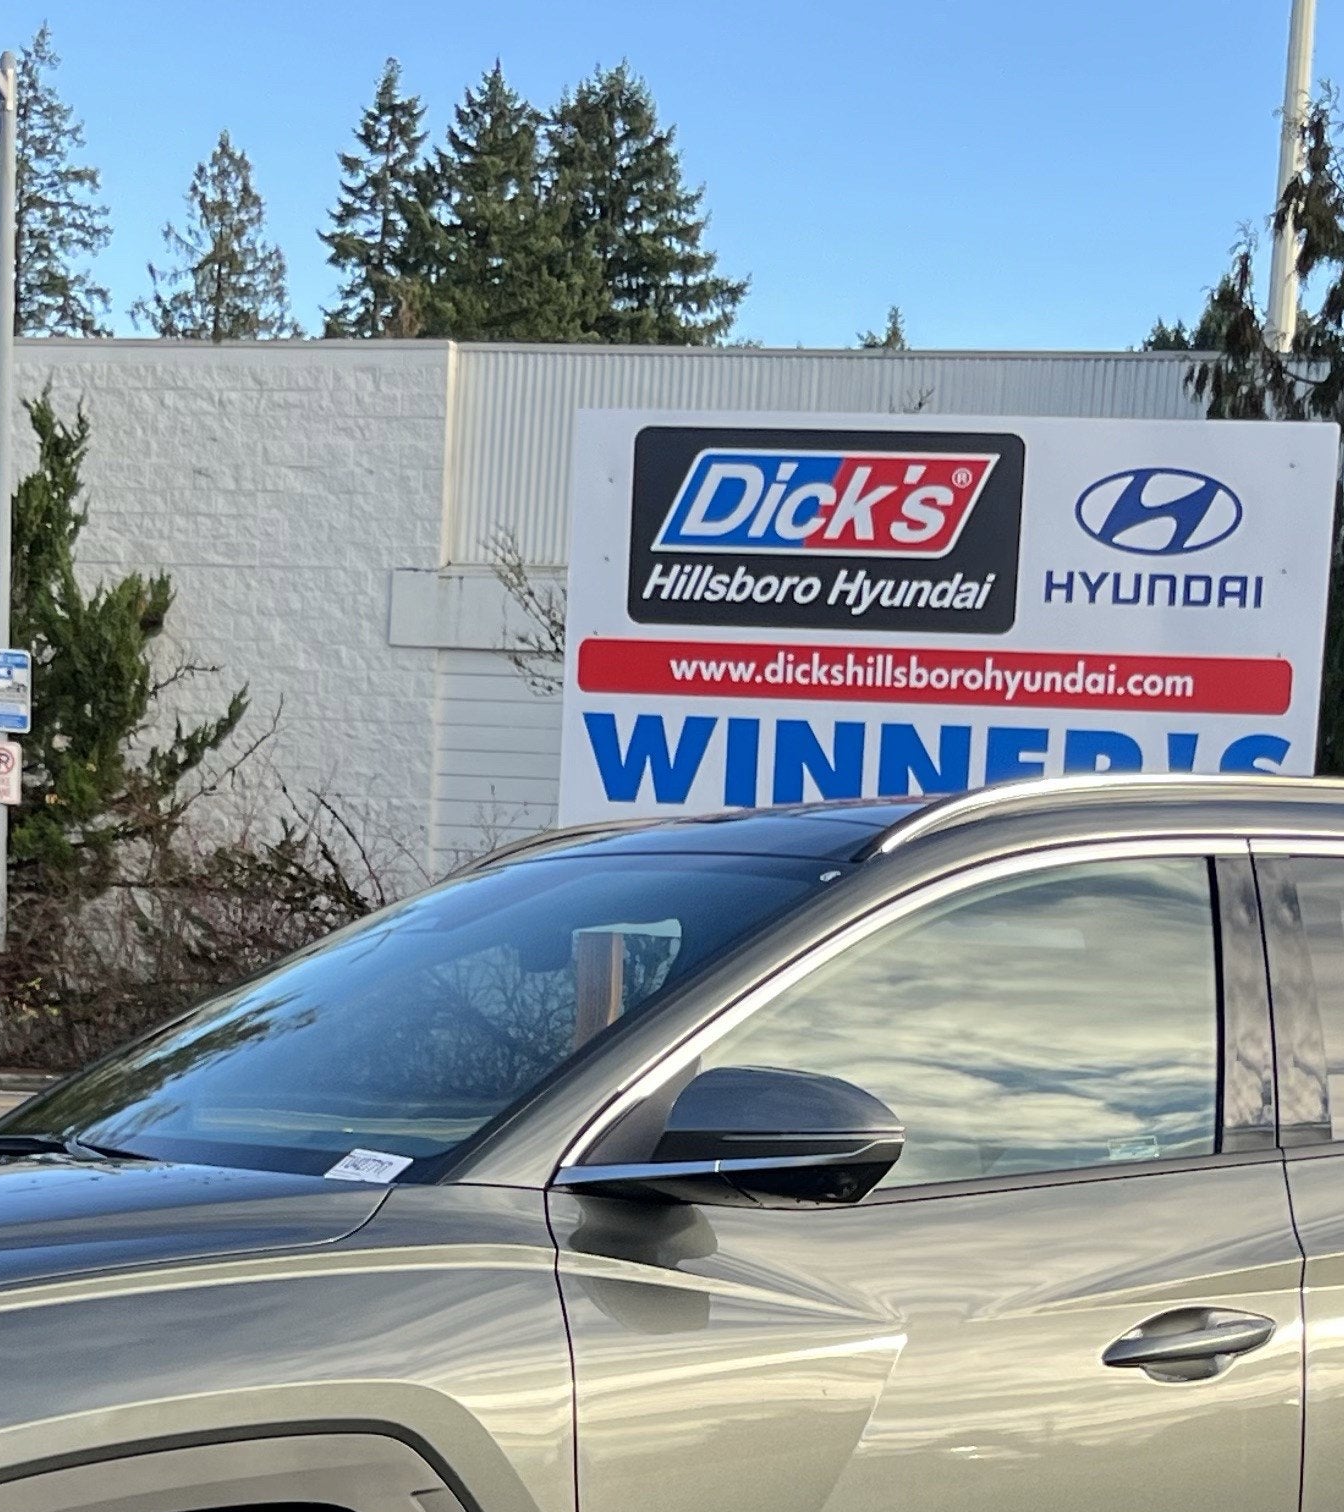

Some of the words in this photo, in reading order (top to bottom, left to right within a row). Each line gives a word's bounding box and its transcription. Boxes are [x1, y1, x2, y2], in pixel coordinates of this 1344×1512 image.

[642, 563, 822, 605] Hillsboro
[826, 569, 996, 616] Hyundai
[1044, 570, 1264, 609] HYUNDAI
[669, 651, 1195, 702] www.dickshillsborohyundai.com
